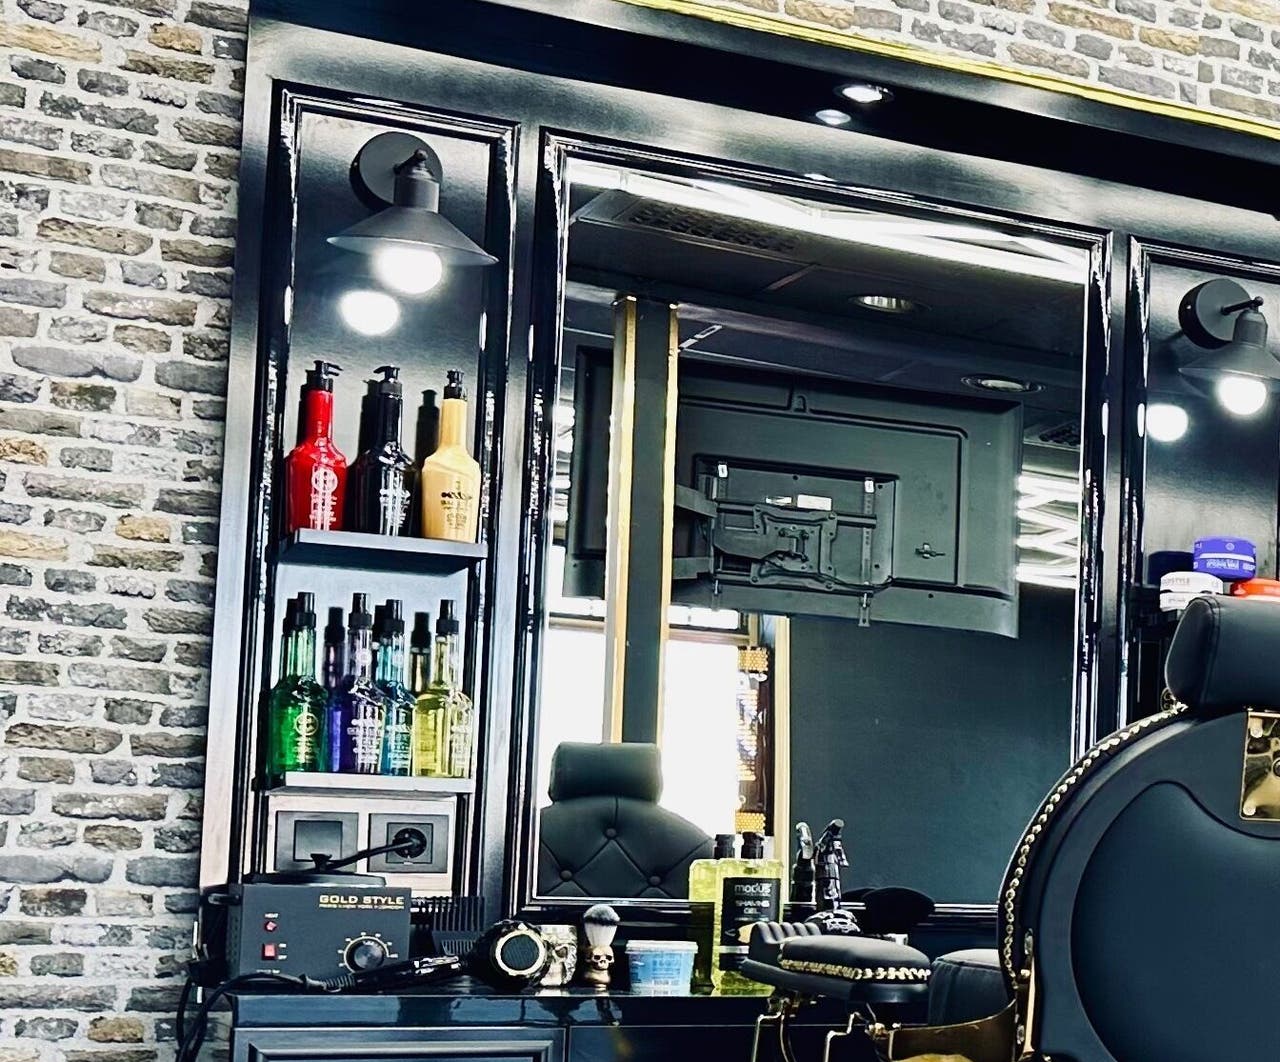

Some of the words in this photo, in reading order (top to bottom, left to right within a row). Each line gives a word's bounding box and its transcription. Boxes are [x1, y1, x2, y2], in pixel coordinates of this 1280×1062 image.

[734, 883, 772, 893] modus
[319, 895, 359, 904] GOLD
[363, 895, 405, 905] STYLE
